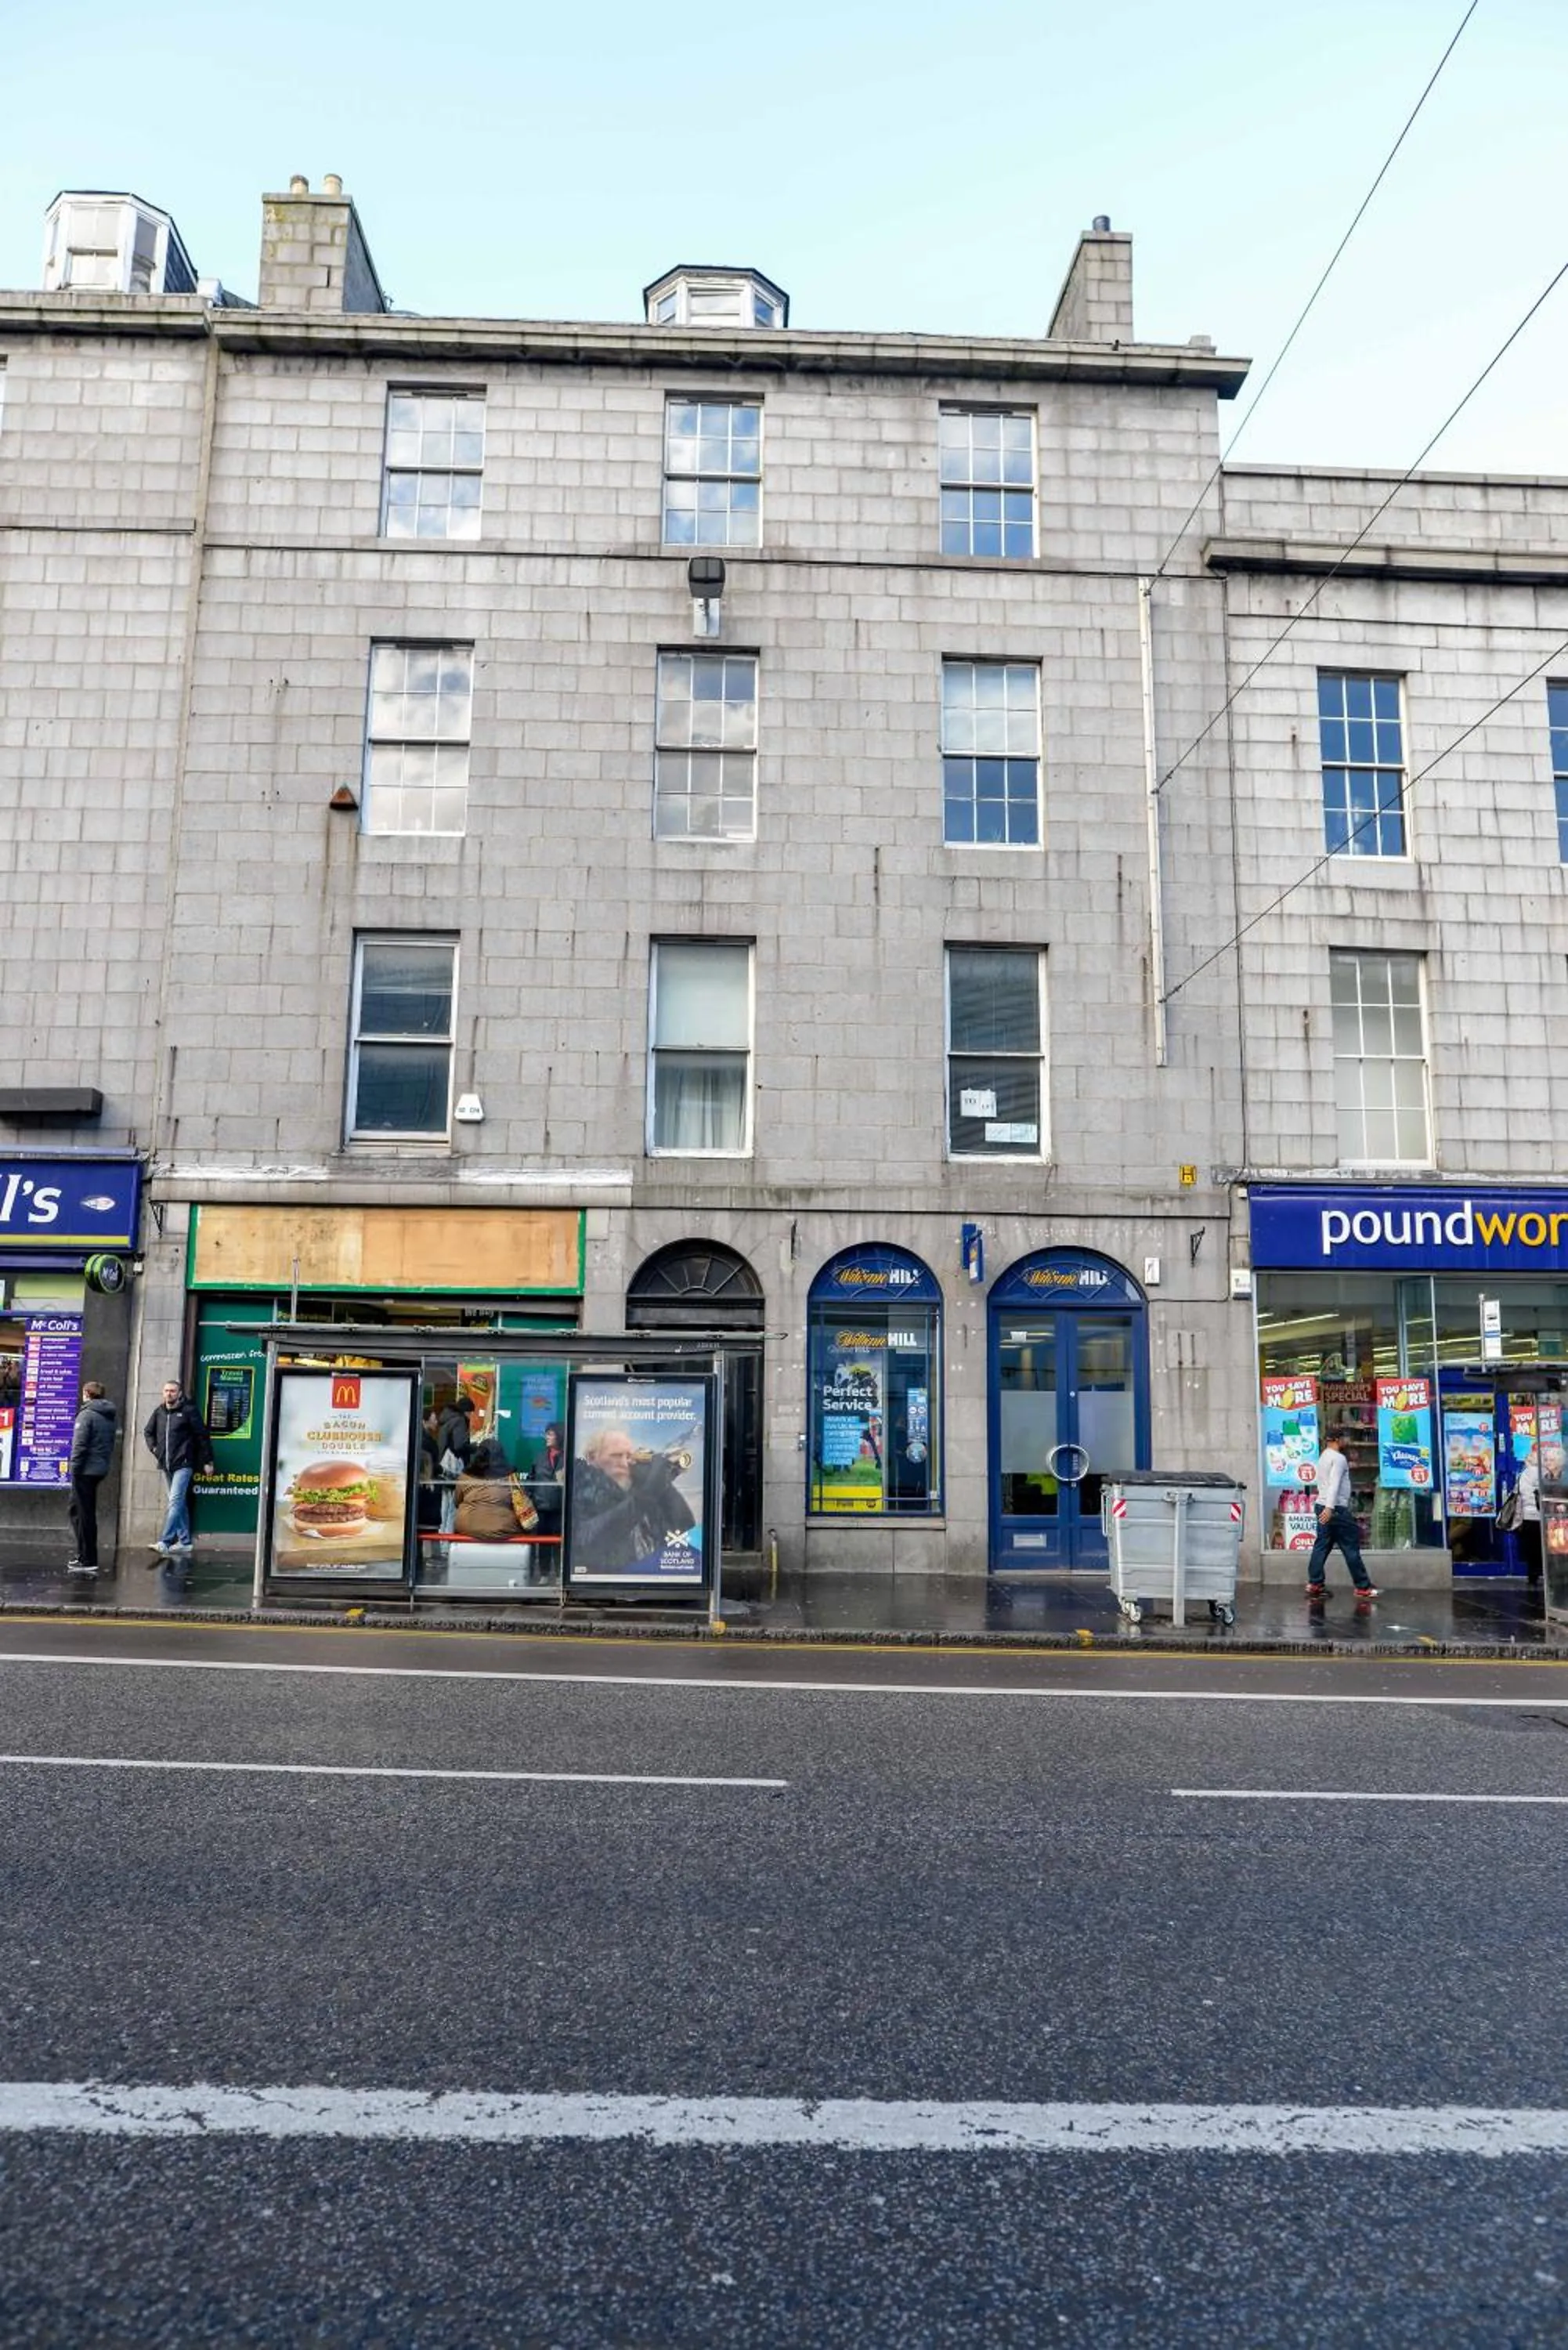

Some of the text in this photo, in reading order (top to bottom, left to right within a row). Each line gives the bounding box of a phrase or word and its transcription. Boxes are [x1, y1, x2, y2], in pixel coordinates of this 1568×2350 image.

[0, 1174, 62, 1223] l's
[1321, 1200, 1568, 1255] poundwor
[887, 1332, 917, 1347] HILL
[823, 1384, 873, 1397] Perfect
[1324, 1391, 1369, 1401] SPECIAL
[1379, 1386, 1400, 1394] YOU
[657, 1397, 692, 1409] popular
[822, 1398, 873, 1410] Service
[1514, 1412, 1533, 1421] YOU
[193, 1473, 259, 1483] Great Rates
[193, 1485, 258, 1495] Guaranteed
